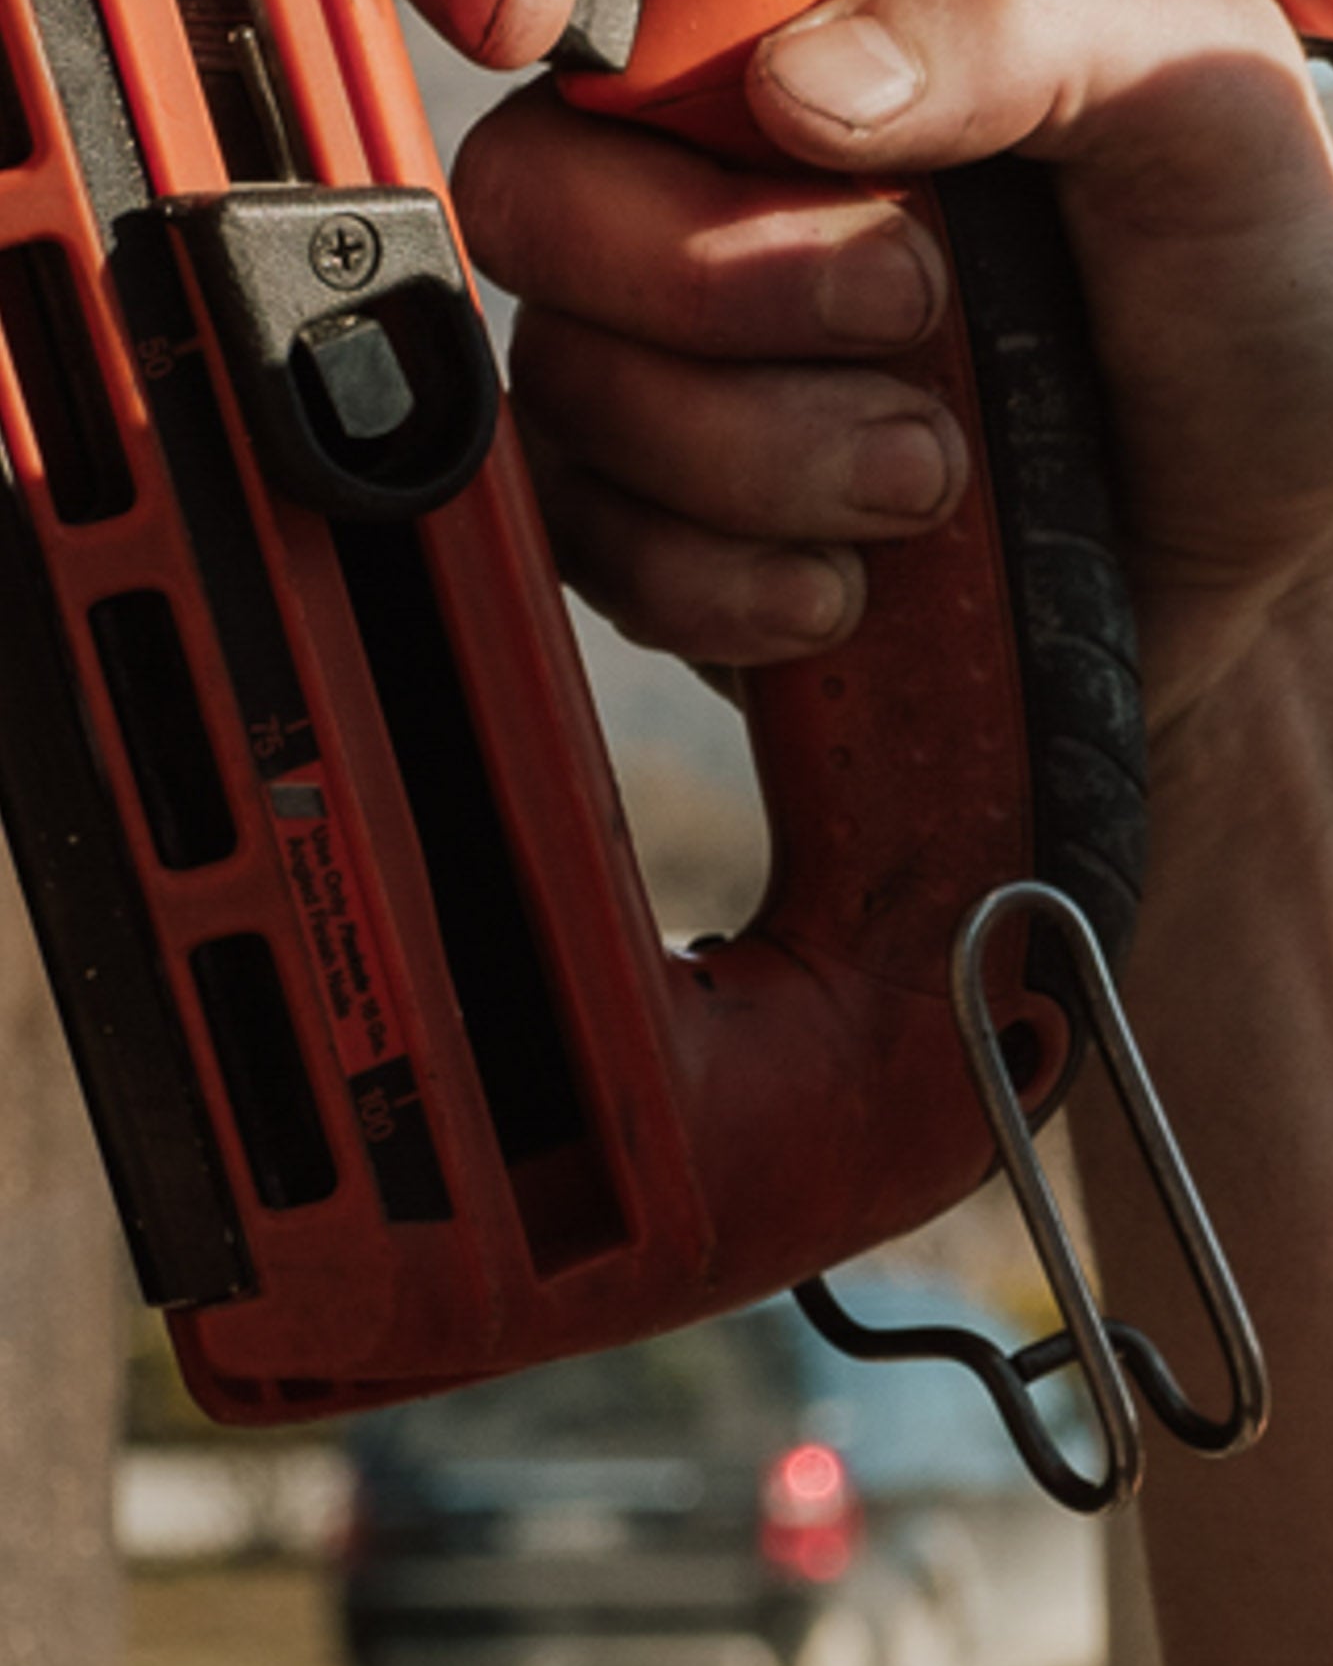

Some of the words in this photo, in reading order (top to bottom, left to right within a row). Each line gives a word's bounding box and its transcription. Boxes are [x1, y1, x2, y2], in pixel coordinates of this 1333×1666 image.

[138, 338, 172, 380] 50
[248, 716, 285, 760] 75
[308, 823, 338, 868] Use
[283, 834, 322, 908] Angled
[317, 868, 353, 920] Only
[357, 1087, 394, 1140] 100
